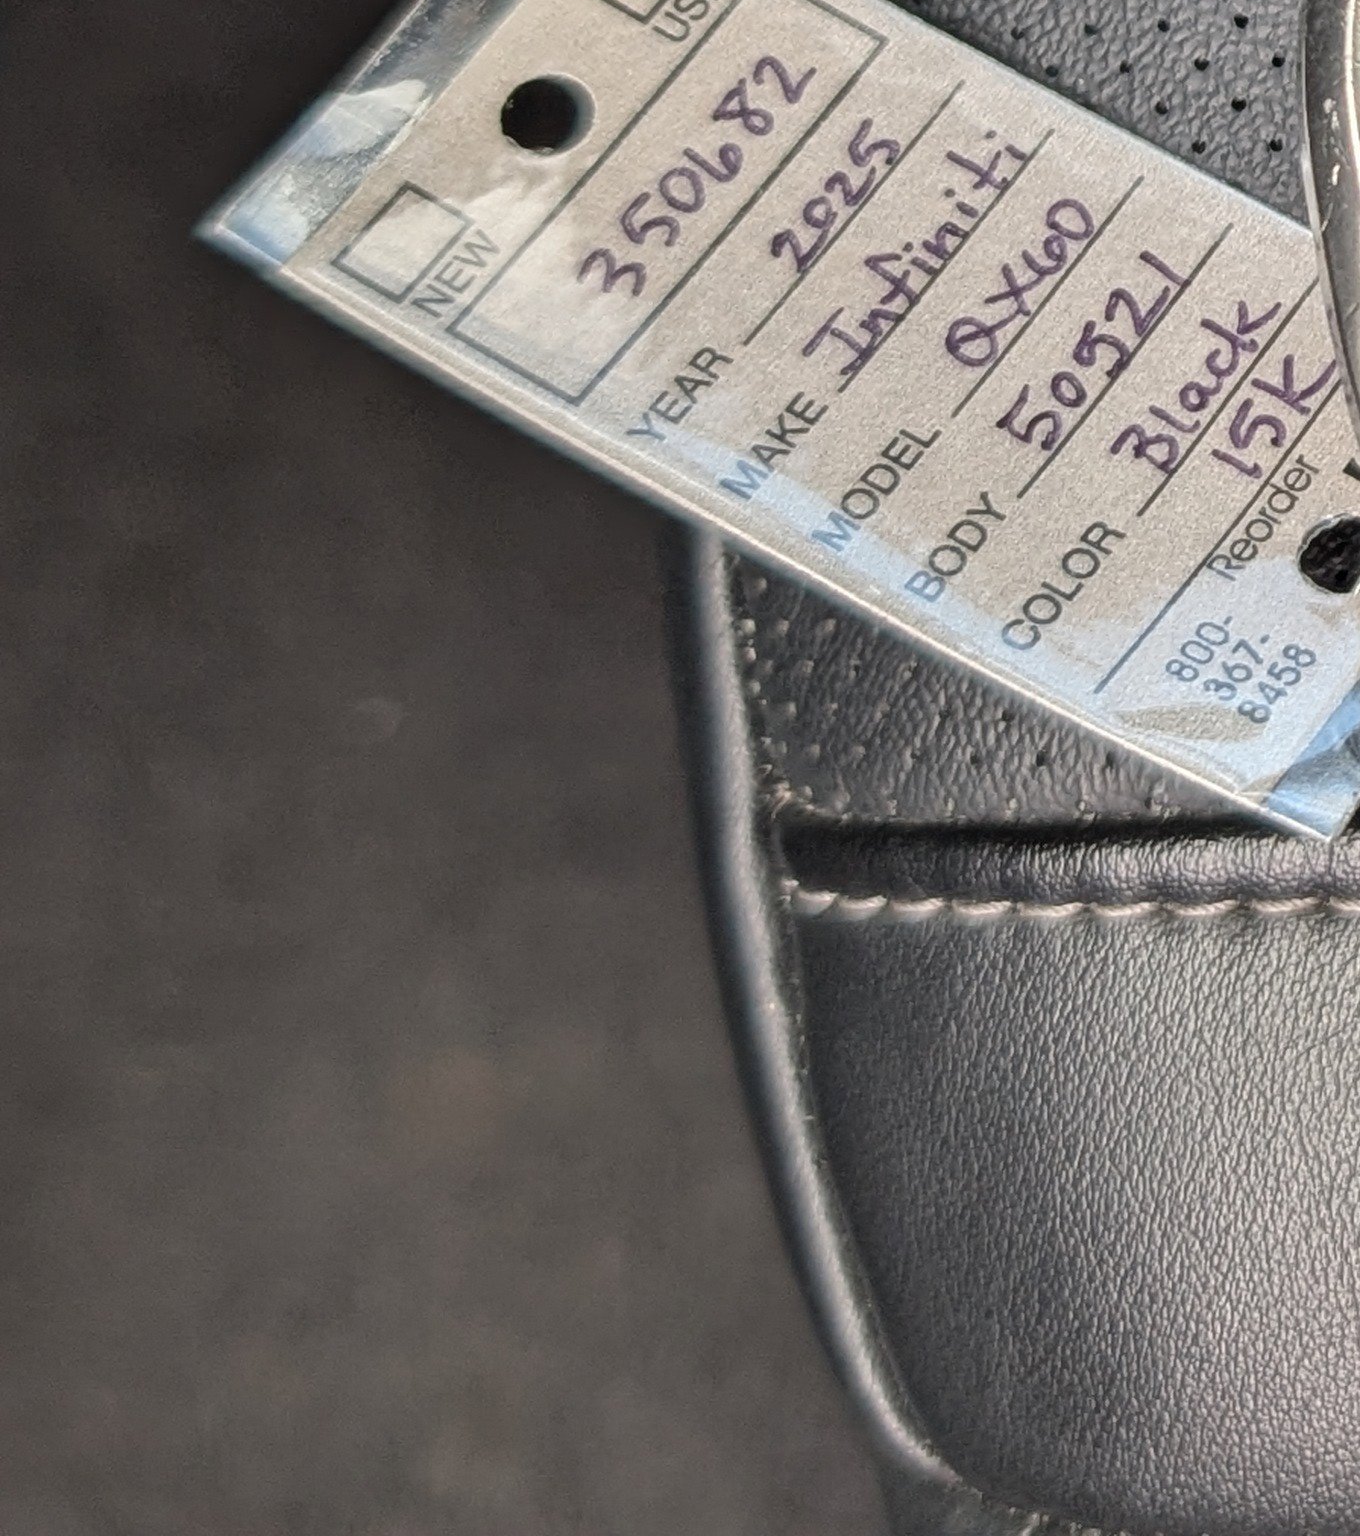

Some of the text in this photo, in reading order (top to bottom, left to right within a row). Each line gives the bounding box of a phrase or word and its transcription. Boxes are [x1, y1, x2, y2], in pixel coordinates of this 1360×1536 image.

[577, 54, 818, 297] 350682
[770, 118, 901, 273] 2025
[410, 230, 502, 317] NEW
[803, 130, 1030, 376] Infiniti
[946, 198, 1097, 366] QX60
[626, 345, 734, 445] YEAR
[995, 249, 1191, 451] 50521
[1111, 301, 1281, 474] Black
[720, 390, 828, 504] MAKE
[1211, 353, 1339, 480] 15K
[811, 429, 941, 554] MODEL
[904, 491, 1007, 603] BODY
[1207, 453, 1321, 582] Reorder
[999, 519, 1126, 652] COLOR
[1165, 616, 1234, 683] 800-
[1204, 634, 1269, 702] 367-
[1237, 642, 1317, 724] 8458
